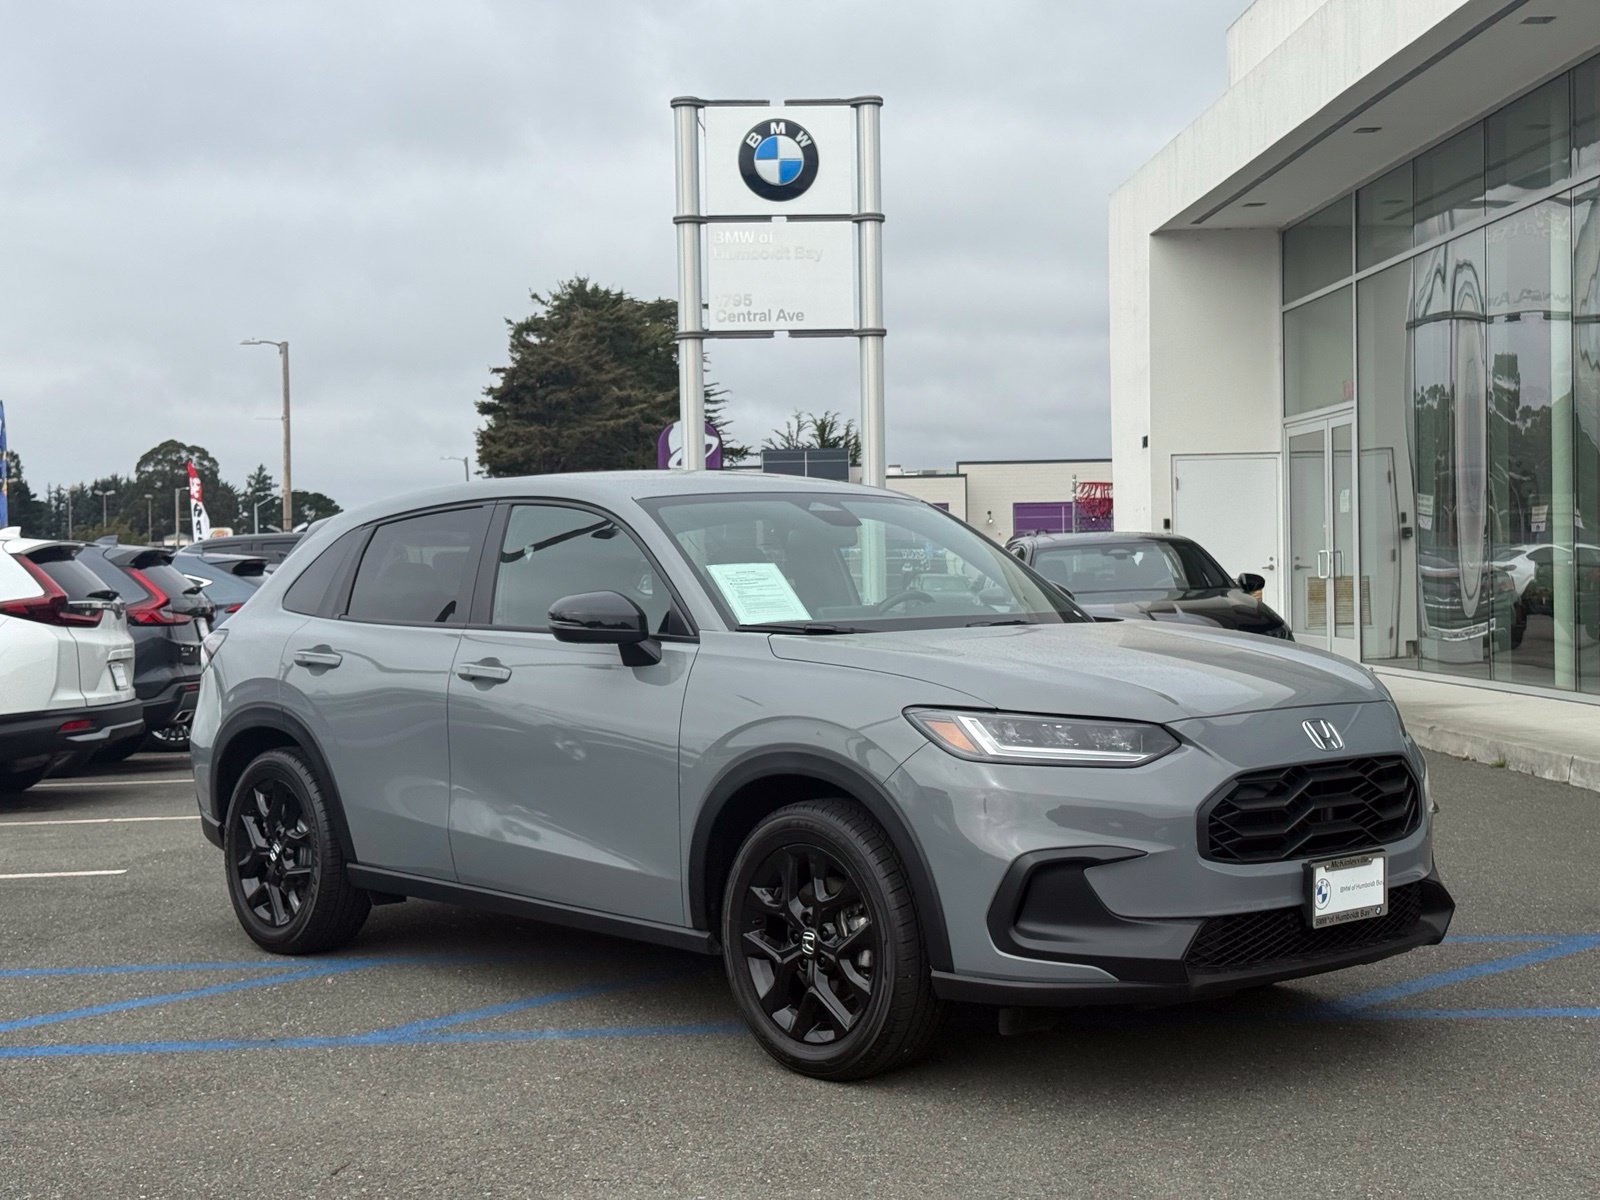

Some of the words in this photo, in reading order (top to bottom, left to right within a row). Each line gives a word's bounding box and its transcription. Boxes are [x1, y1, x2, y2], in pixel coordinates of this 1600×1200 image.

[746, 122, 812, 149] BMW
[713, 231, 755, 244] BMW
[716, 308, 772, 323] Central
[775, 308, 805, 322] Ave
